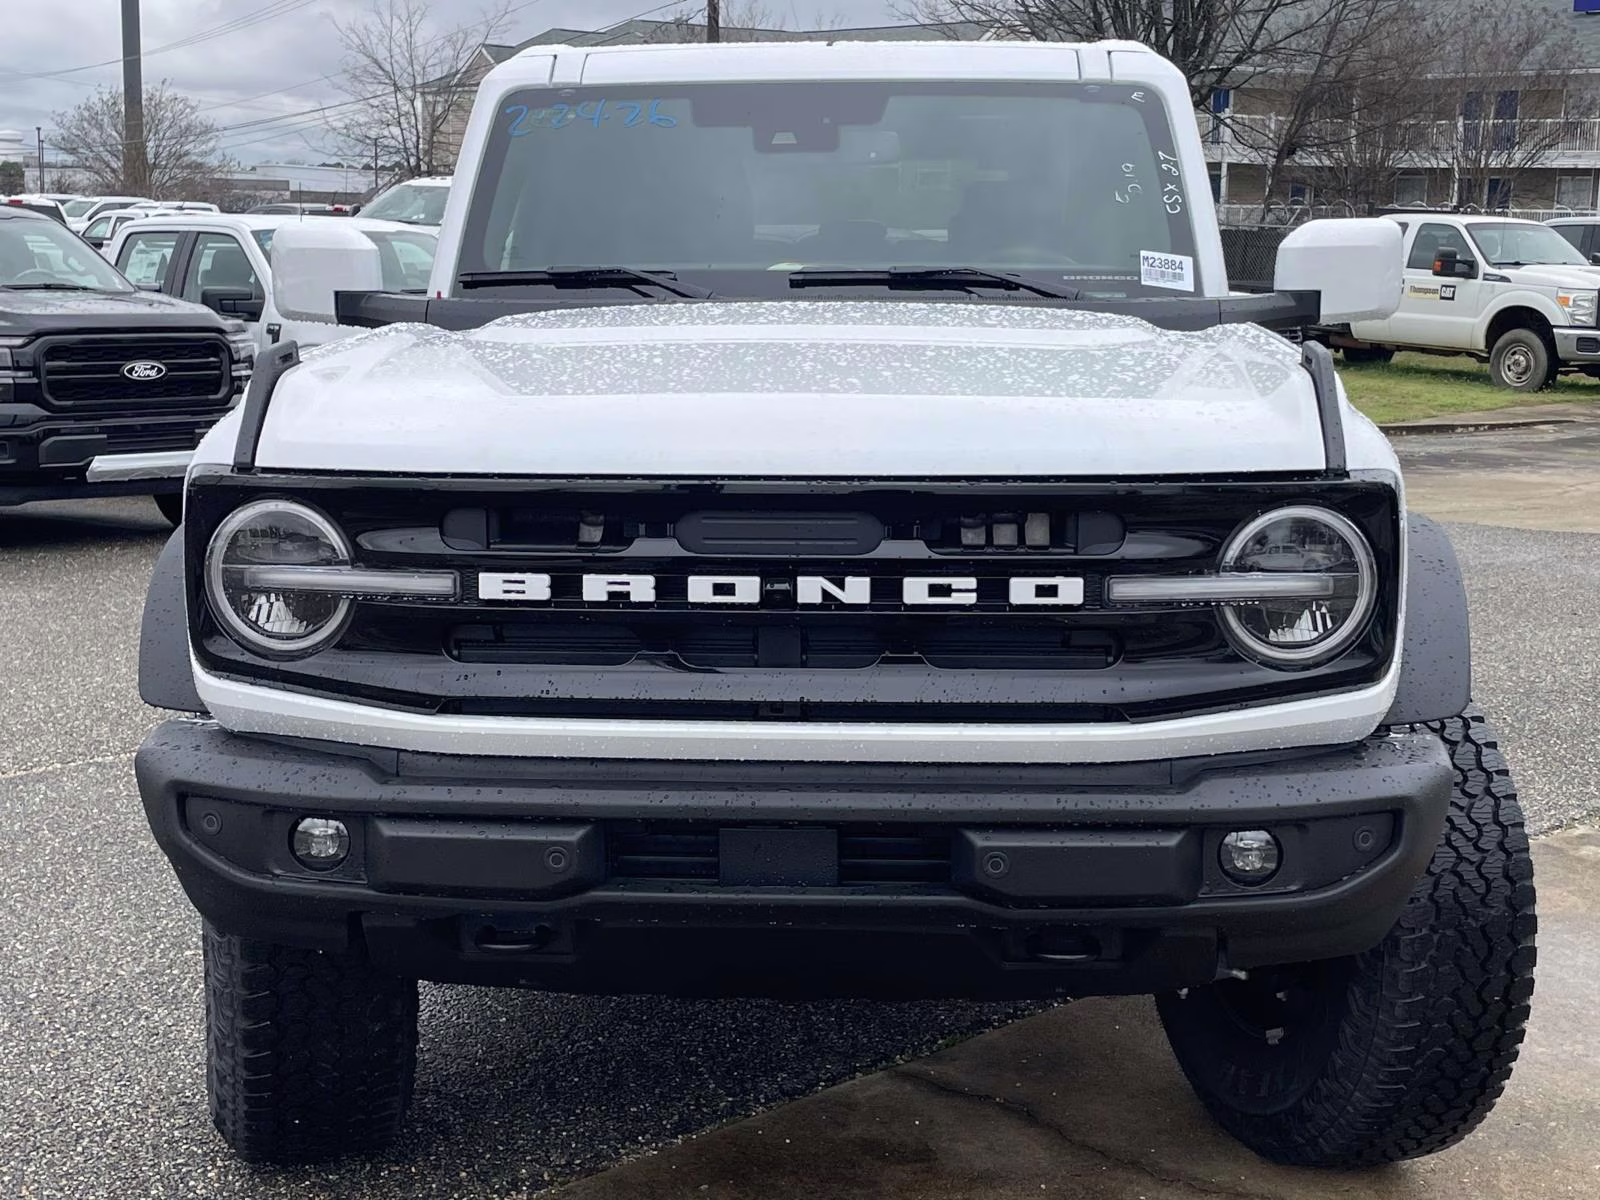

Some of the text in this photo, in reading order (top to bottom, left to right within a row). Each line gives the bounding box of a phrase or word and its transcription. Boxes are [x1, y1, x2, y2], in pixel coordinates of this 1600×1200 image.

[1142, 255, 1184, 272] M23884
[1441, 286, 1455, 297] CAT
[131, 364, 159, 377] Ford
[478, 572, 1084, 605] BRONCO
